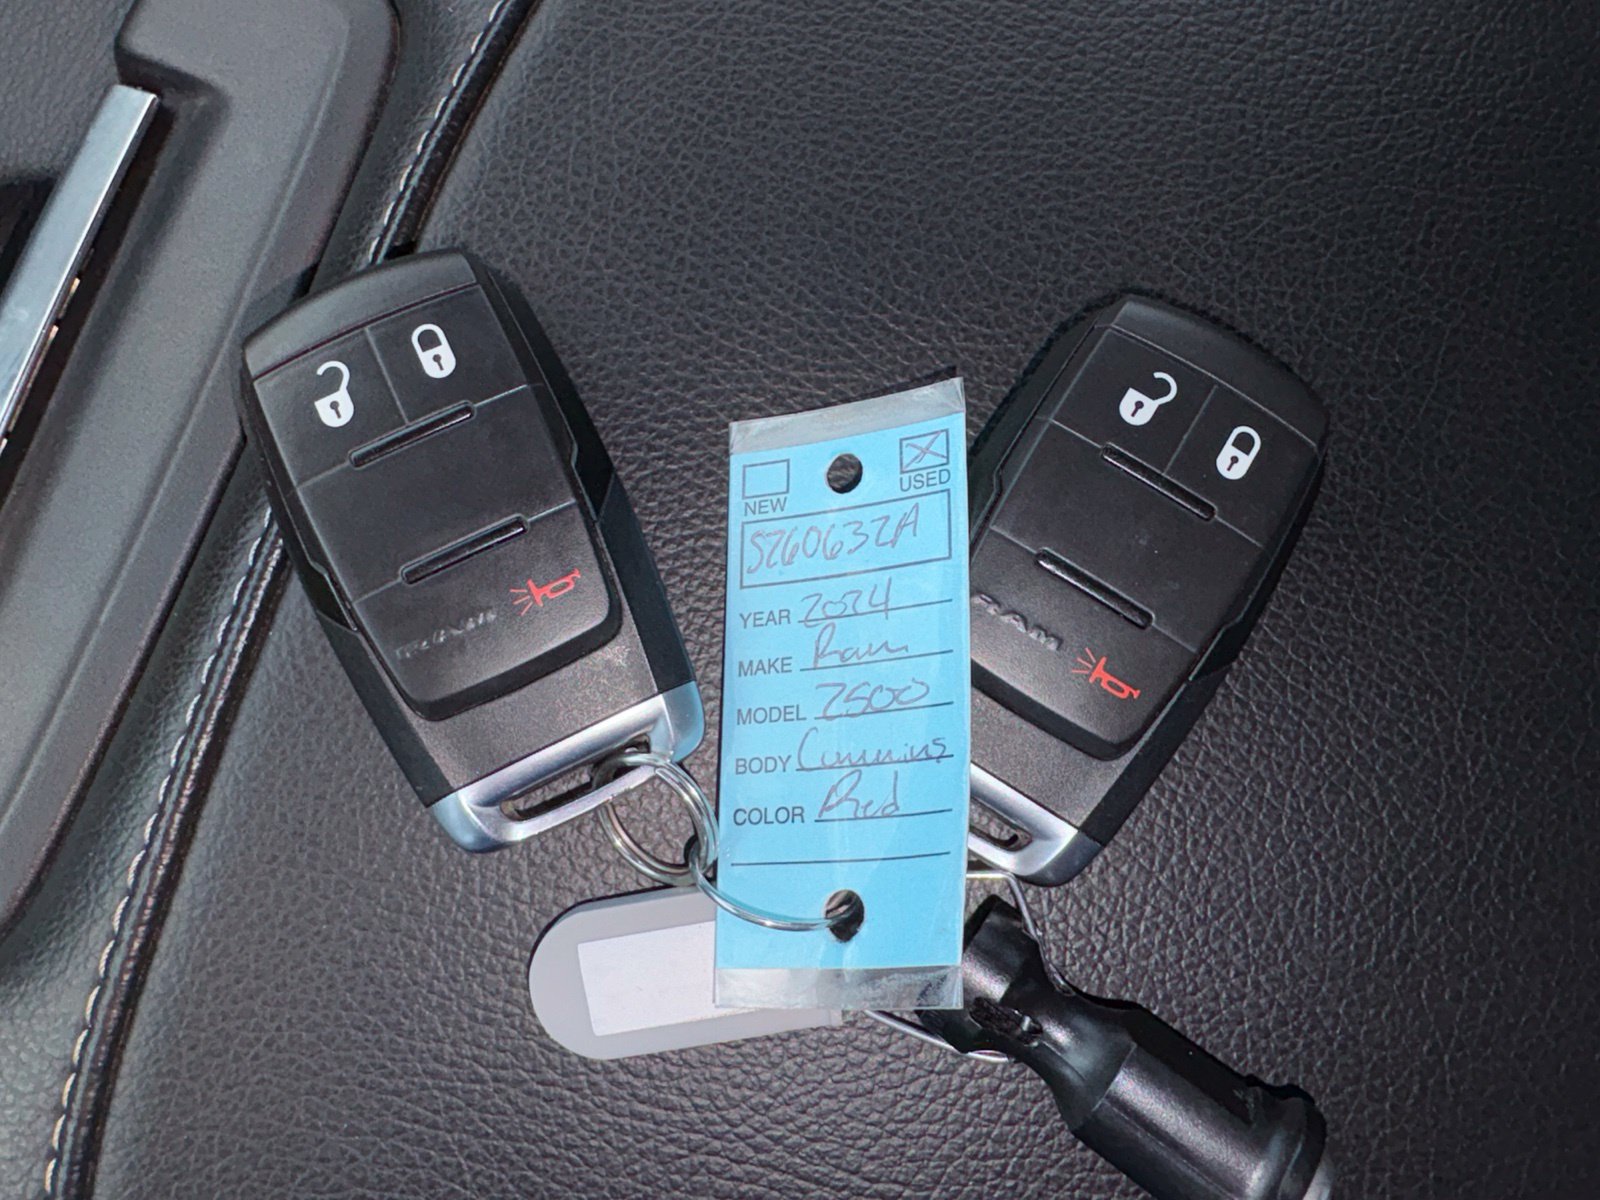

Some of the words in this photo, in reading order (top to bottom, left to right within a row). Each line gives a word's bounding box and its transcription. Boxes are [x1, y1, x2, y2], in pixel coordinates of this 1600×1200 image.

[899, 469, 951, 492] USED
[744, 497, 788, 516] NEW
[740, 609, 791, 630] YEAR
[801, 576, 892, 628] 2024
[738, 657, 793, 678] MAKE
[812, 622, 908, 670] Ram
[736, 705, 807, 725] MODEL
[815, 677, 930, 721] 2500
[735, 755, 792, 775] BODY
[733, 806, 805, 826] COLOR
[817, 770, 900, 819] Red
